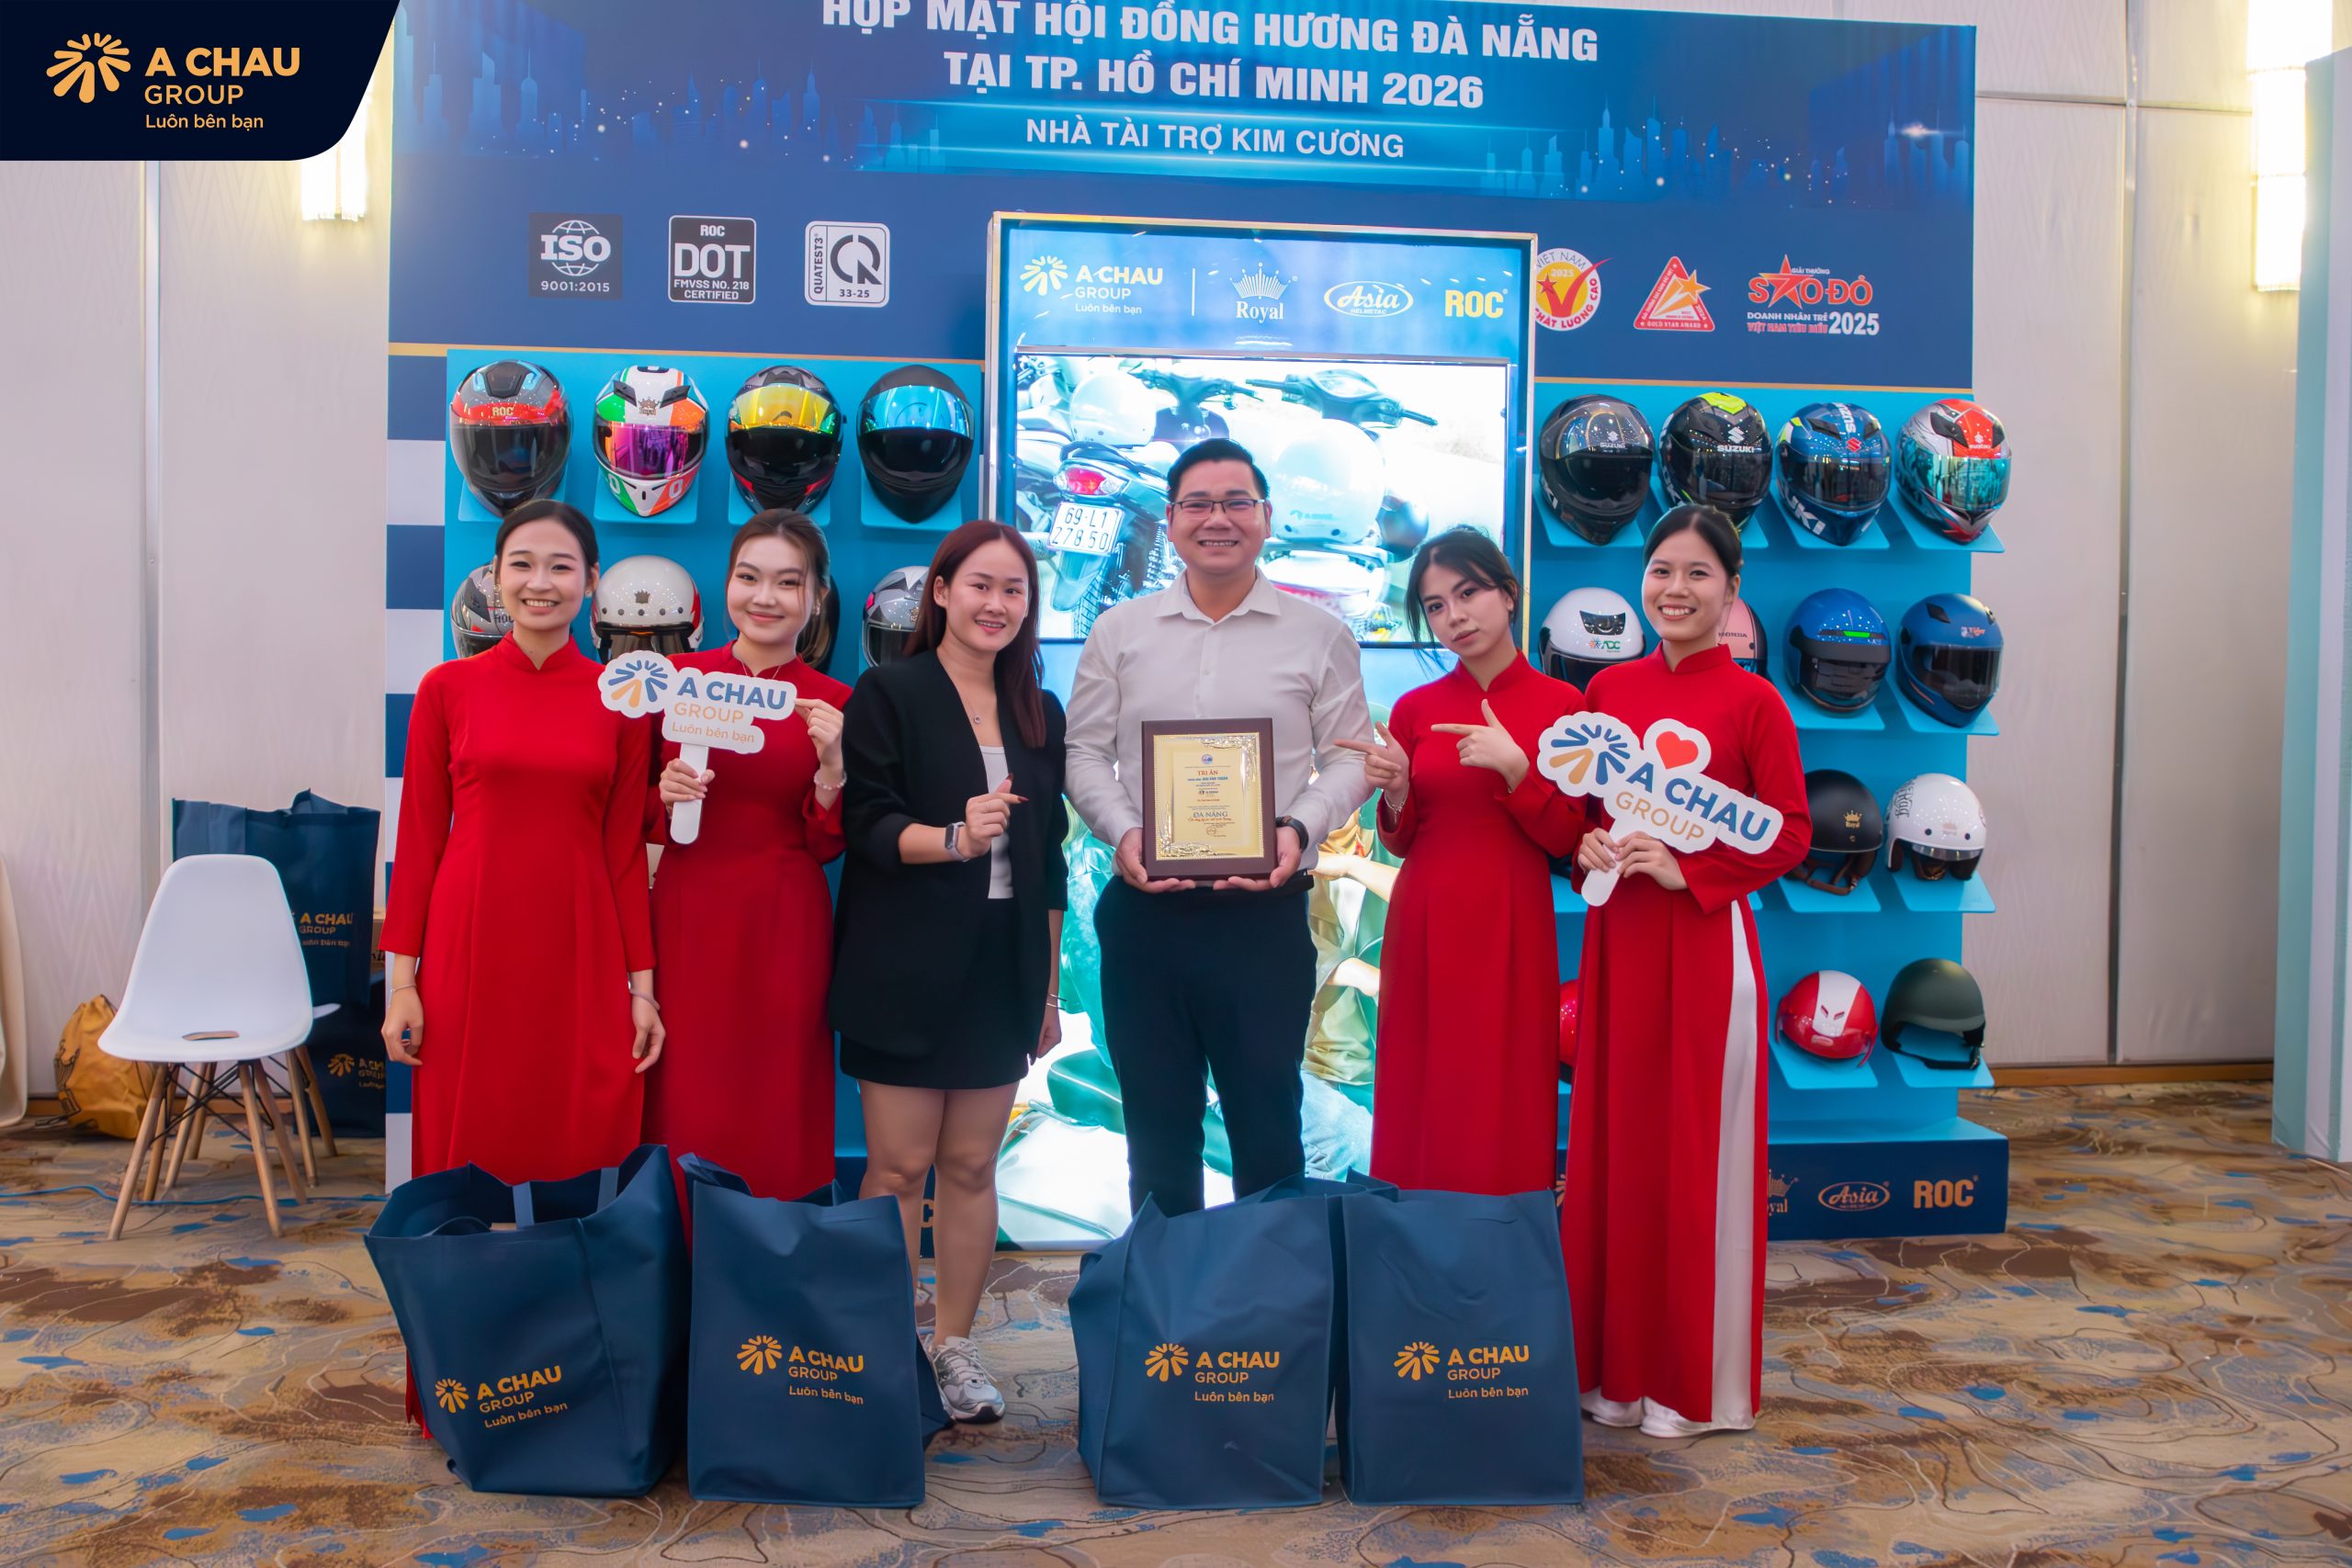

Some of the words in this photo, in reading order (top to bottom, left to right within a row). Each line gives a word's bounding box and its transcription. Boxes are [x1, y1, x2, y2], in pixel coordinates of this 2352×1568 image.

[823, 0, 910, 34] HỌP
[1035, 0, 1105, 44] HỘI
[1120, 0, 1239, 44] ĐỒNG
[1254, 12, 1397, 52] HƯƠNG
[1411, 16, 1469, 55] ĐÀ
[1482, 14, 1598, 62] NẴNG
[944, 51, 1011, 94] TẠI
[1025, 55, 1082, 90] TP.
[1099, 50, 1155, 94] HỒ
[1170, 58, 1240, 98] CHÍ
[1255, 66, 1369, 104] MINH
[1383, 73, 1484, 108] 2026
[1026, 114, 1091, 144] NHÀ
[1101, 117, 1148, 147] TÀI
[1159, 122, 1223, 154] TRỢ
[1233, 129, 1285, 152] KIM
[1295, 129, 1404, 158] CƯƠNG
[700, 224, 725, 236] ROC
[540, 234, 611, 262] ISO
[674, 243, 751, 278] DOT
[814, 237, 823, 294] QUATEST3
[673, 278, 710, 288] FMVSS
[712, 280, 730, 289] NO.
[732, 281, 750, 290] 218
[1076, 265, 1092, 283] A
[1098, 265, 1163, 285] CHAU
[540, 280, 610, 293] 9001:2015
[684, 289, 740, 300] CERTIFIED
[839, 288, 870, 299] 33-25
[1074, 287, 1131, 299] GROUP
[1337, 285, 1400, 309] Asia
[1825, 275, 1873, 305] ĐỎ
[1075, 303, 1100, 313] Luôn
[1102, 304, 1121, 313] bên
[1124, 305, 1142, 315] bạn
[1236, 300, 1283, 323] Royal
[1445, 289, 1503, 318] ROC
[1747, 312, 1781, 321] DOANH
[1783, 312, 1812, 321] NHÂN
[1828, 311, 1880, 335] 2025
[492, 405, 514, 416] ROC
[1717, 445, 1755, 453] SUZUKI
[677, 677, 698, 699] A
[706, 681, 787, 710] CHAU
[673, 702, 744, 724] GROUP
[672, 721, 702, 736] Luôn
[706, 727, 729, 739] bên
[731, 730, 755, 744] bạn
[1624, 761, 1654, 793] A
[1665, 777, 1771, 841] CHAU
[1615, 790, 1704, 840] GROUP
[300, 912, 311, 924] A
[1828, 1185, 1879, 1205] Asia
[1914, 1179, 1974, 1209] ROC
[788, 1346, 806, 1363] A
[808, 1349, 865, 1374] CHAU
[1196, 1351, 1214, 1369] A
[1218, 1351, 1280, 1370] CHAU
[1447, 1348, 1464, 1366] A
[1468, 1345, 1530, 1365] CHAU
[477, 1382, 496, 1401] A
[497, 1365, 563, 1395] CHAU
[788, 1366, 838, 1382] GROUP
[1194, 1371, 1250, 1384] GROUP
[1447, 1368, 1501, 1381] GROUP
[479, 1391, 535, 1414] GROUP
[789, 1384, 819, 1397] Luôn
[821, 1387, 842, 1400] bên
[844, 1392, 864, 1404] bạn
[1194, 1391, 1224, 1402] Luôn
[1227, 1391, 1250, 1402] bên
[1252, 1392, 1274, 1404] bạn
[1448, 1388, 1477, 1399] Luôn
[1481, 1387, 1504, 1398] bên
[1507, 1387, 1529, 1398] bạn
[484, 1414, 515, 1428] Luôn
[517, 1407, 542, 1424] bên
[545, 1402, 568, 1417] bạn
